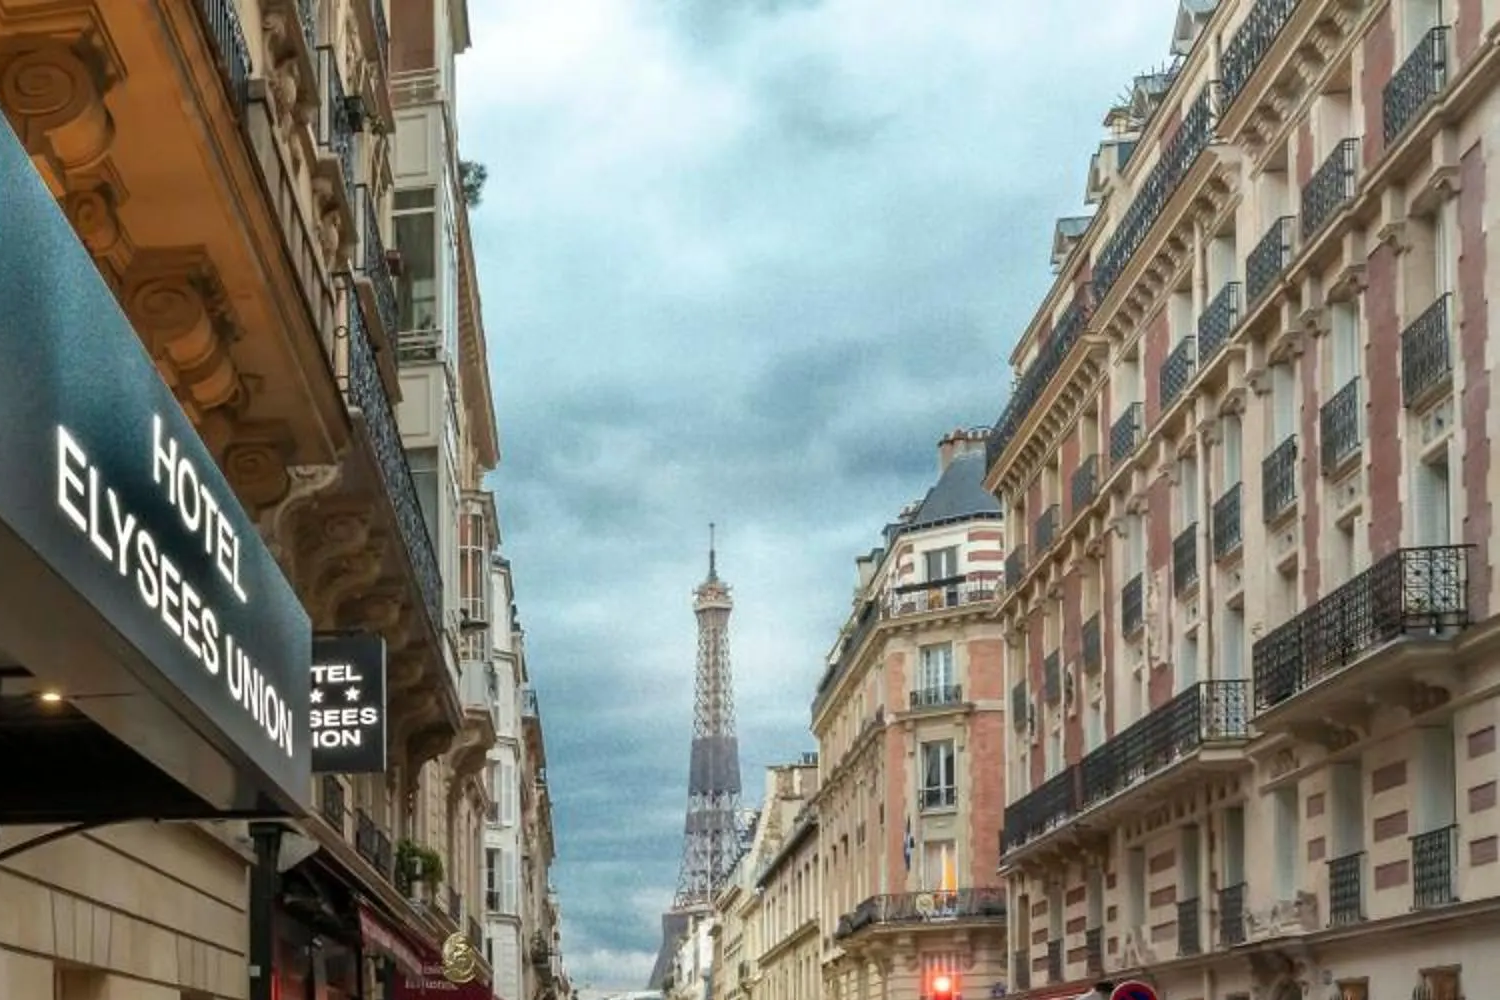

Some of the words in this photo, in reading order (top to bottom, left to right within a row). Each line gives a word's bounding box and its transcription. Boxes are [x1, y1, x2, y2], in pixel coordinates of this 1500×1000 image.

[152, 413, 248, 604] HOTEL
[57, 424, 219, 675] ELYSEES
[225, 634, 293, 758] UNION
[310, 664, 363, 684] TEL
[309, 707, 377, 728] SEES
[313, 729, 361, 748] ION
